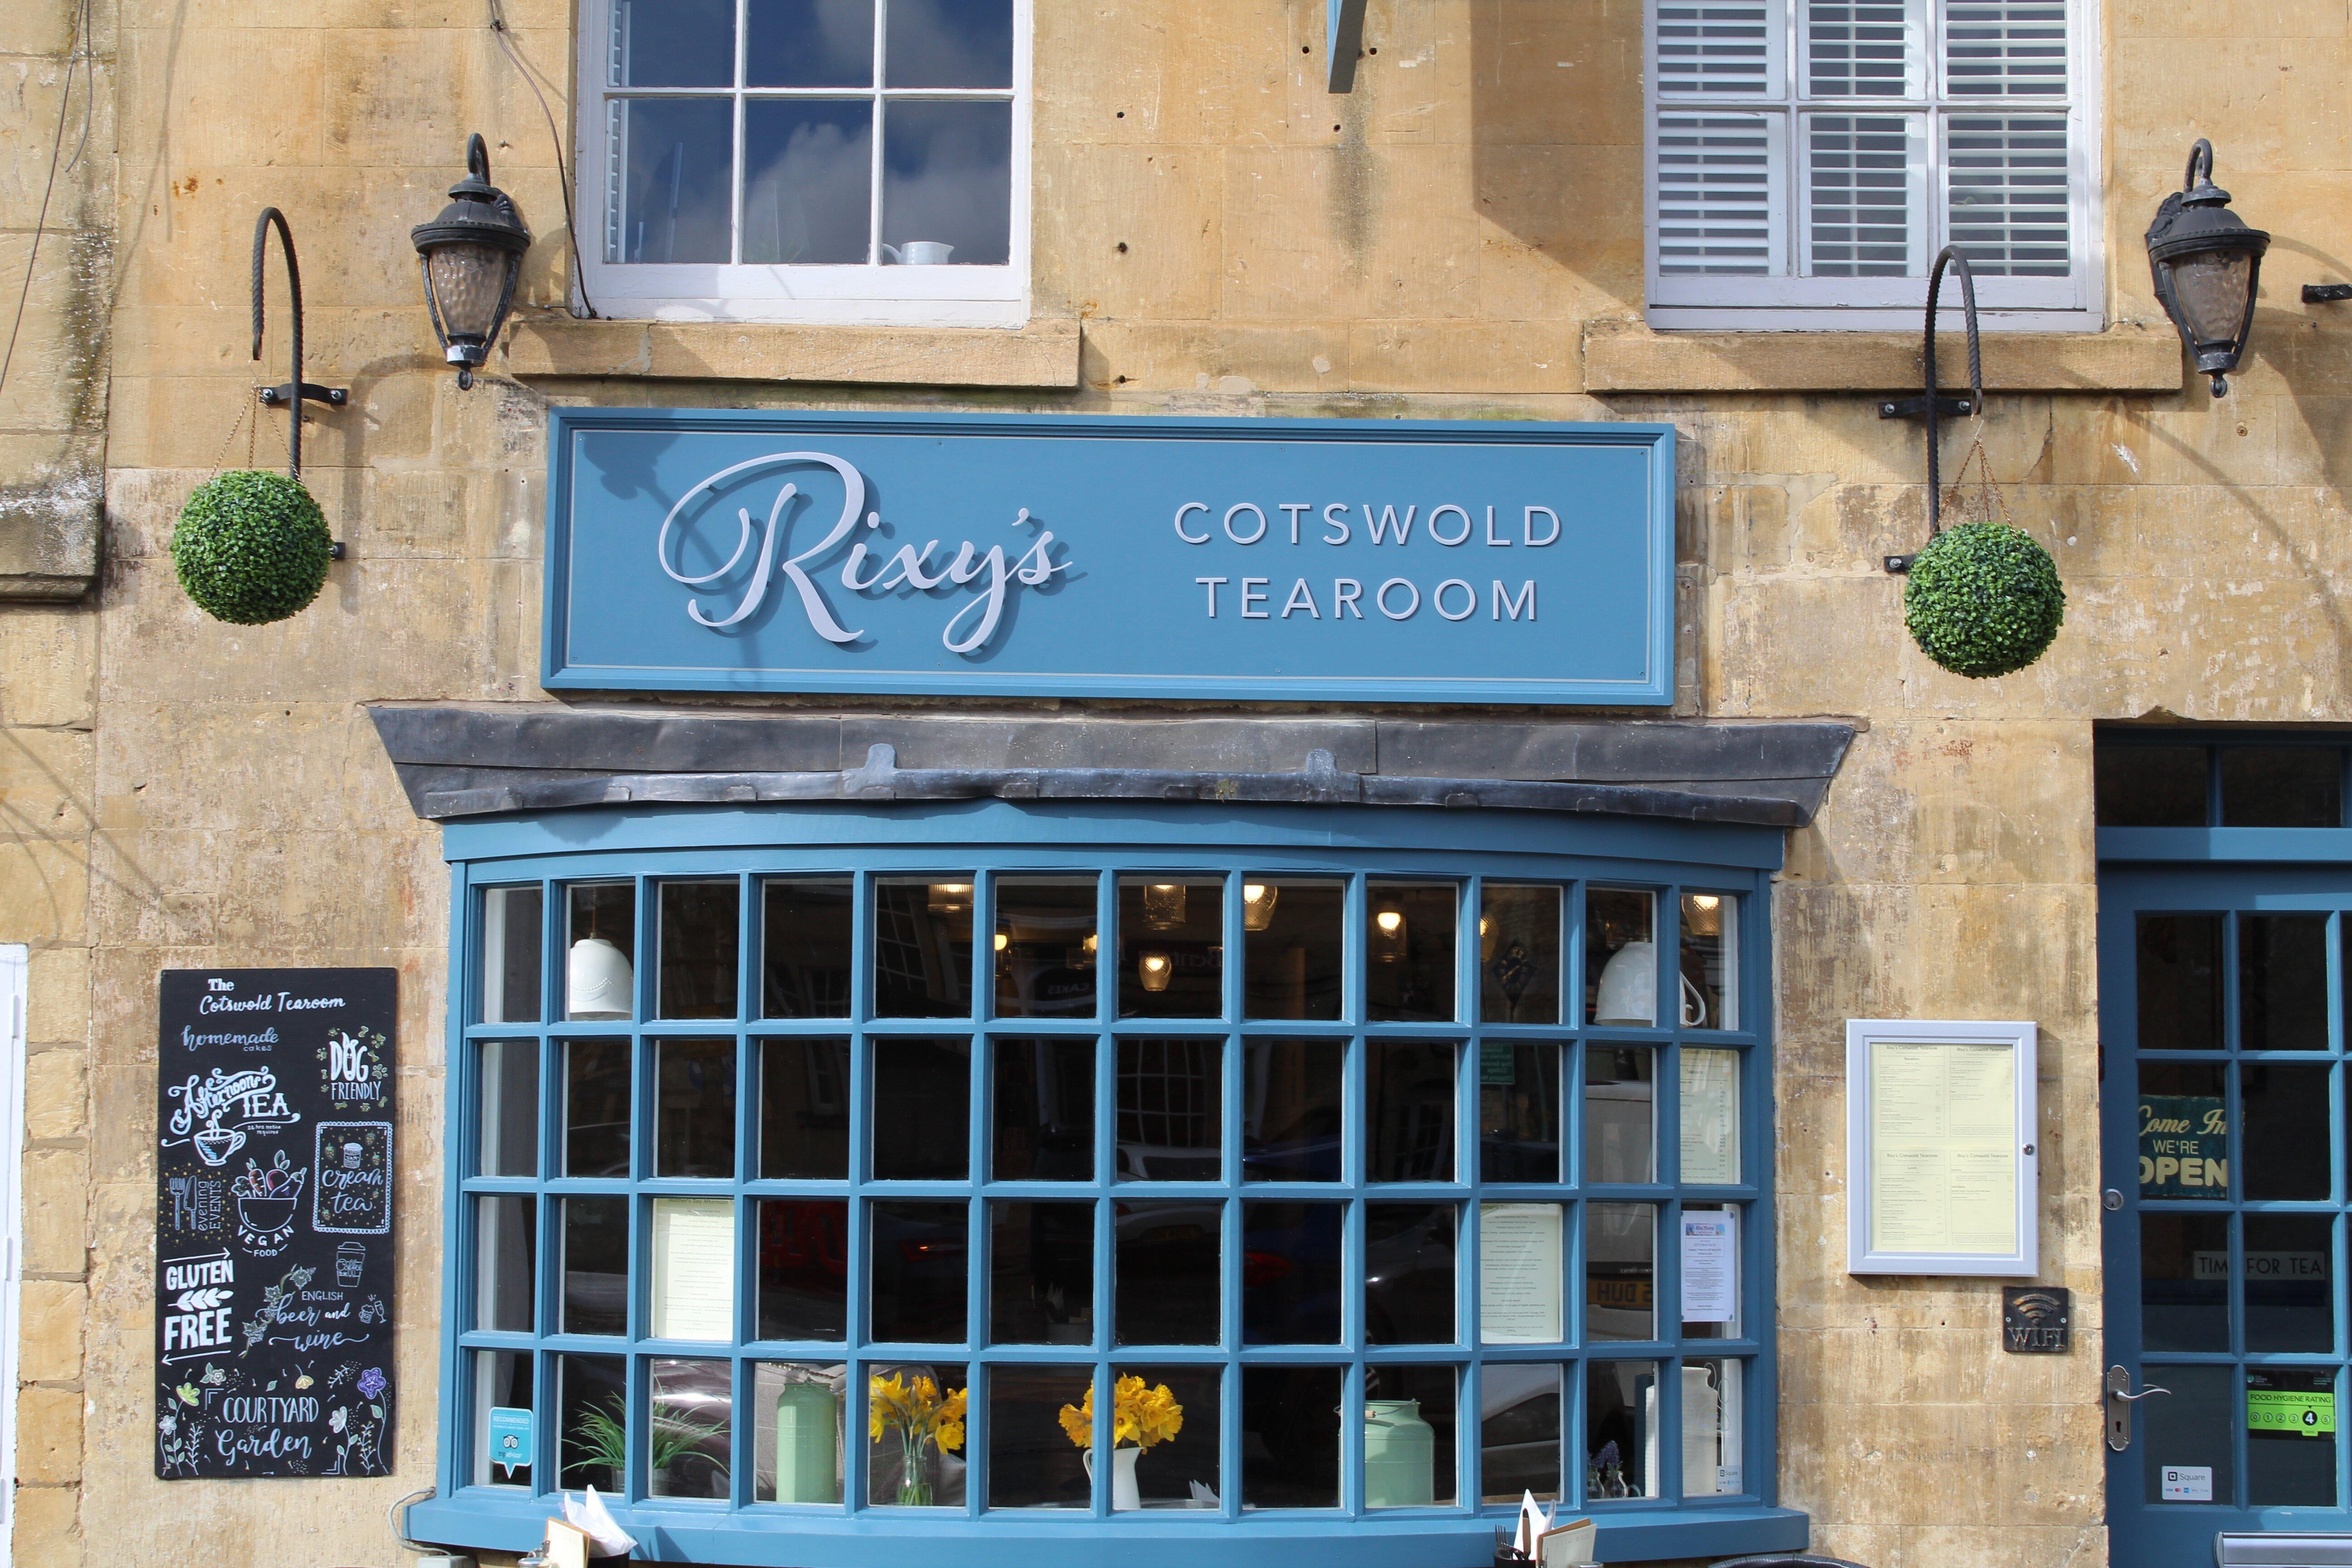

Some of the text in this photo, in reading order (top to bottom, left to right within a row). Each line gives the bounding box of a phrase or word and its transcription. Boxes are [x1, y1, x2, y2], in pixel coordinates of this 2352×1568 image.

[1175, 502, 1561, 547] COTSWOLD
[658, 451, 1073, 653] Rixy's
[1196, 577, 1536, 621] TEAROOM
[208, 978, 235, 991] The
[200, 992, 346, 1014] Cotswold Tearoom
[181, 1025, 279, 1051] homemade
[329, 1032, 369, 1082] DOG
[331, 1081, 382, 1101] FRIENDLY
[168, 1074, 262, 1135] Afternoon
[243, 1093, 291, 1118] TEA
[2153, 1139, 2199, 1154] WE'RE
[322, 1169, 383, 1190] cream
[2139, 1156, 2228, 1187] OPEN
[198, 1181, 209, 1231] evening
[209, 1180, 222, 1229] EVENTS
[330, 1192, 372, 1213] tea
[237, 1225, 294, 1246] VEGAN
[166, 1259, 234, 1291] GLUTEN
[2199, 1257, 2323, 1274] TIM FOR TEA
[302, 1291, 343, 1301] ENGLISH
[255, 1293, 351, 1327] beer and
[164, 1307, 232, 1351] FREE
[269, 1329, 370, 1352] wine
[2007, 1328, 2065, 1351] WIFI
[224, 1396, 319, 1424] COURTYARD
[2305, 1412, 2314, 1424] 4
[215, 1428, 312, 1466] Garden
[2180, 1473, 2205, 1481] Square
